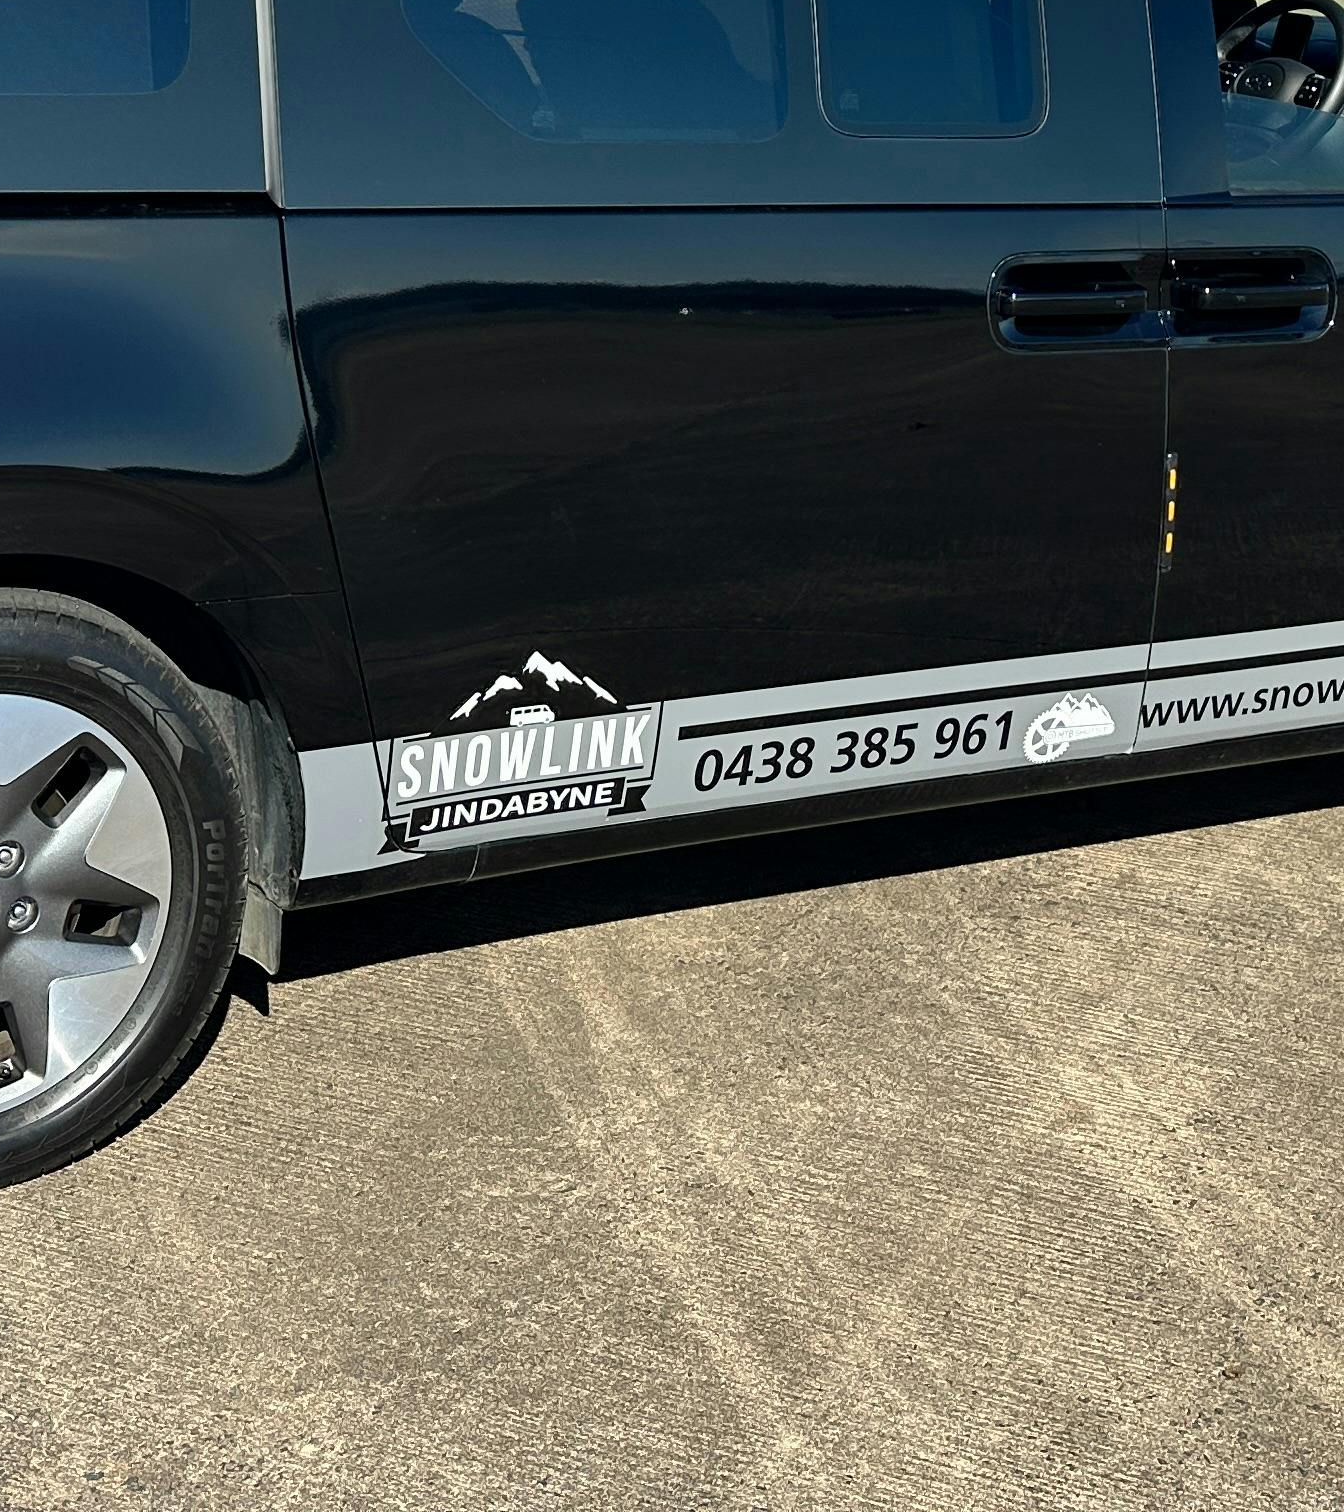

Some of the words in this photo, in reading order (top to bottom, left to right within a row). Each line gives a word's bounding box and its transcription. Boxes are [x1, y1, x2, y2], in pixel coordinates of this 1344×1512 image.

[397, 714, 652, 798] SNOWLINK
[694, 736, 816, 792] 0438
[830, 722, 919, 774] 385
[933, 710, 1014, 760] 961
[419, 781, 616, 833] JINDABYNE
